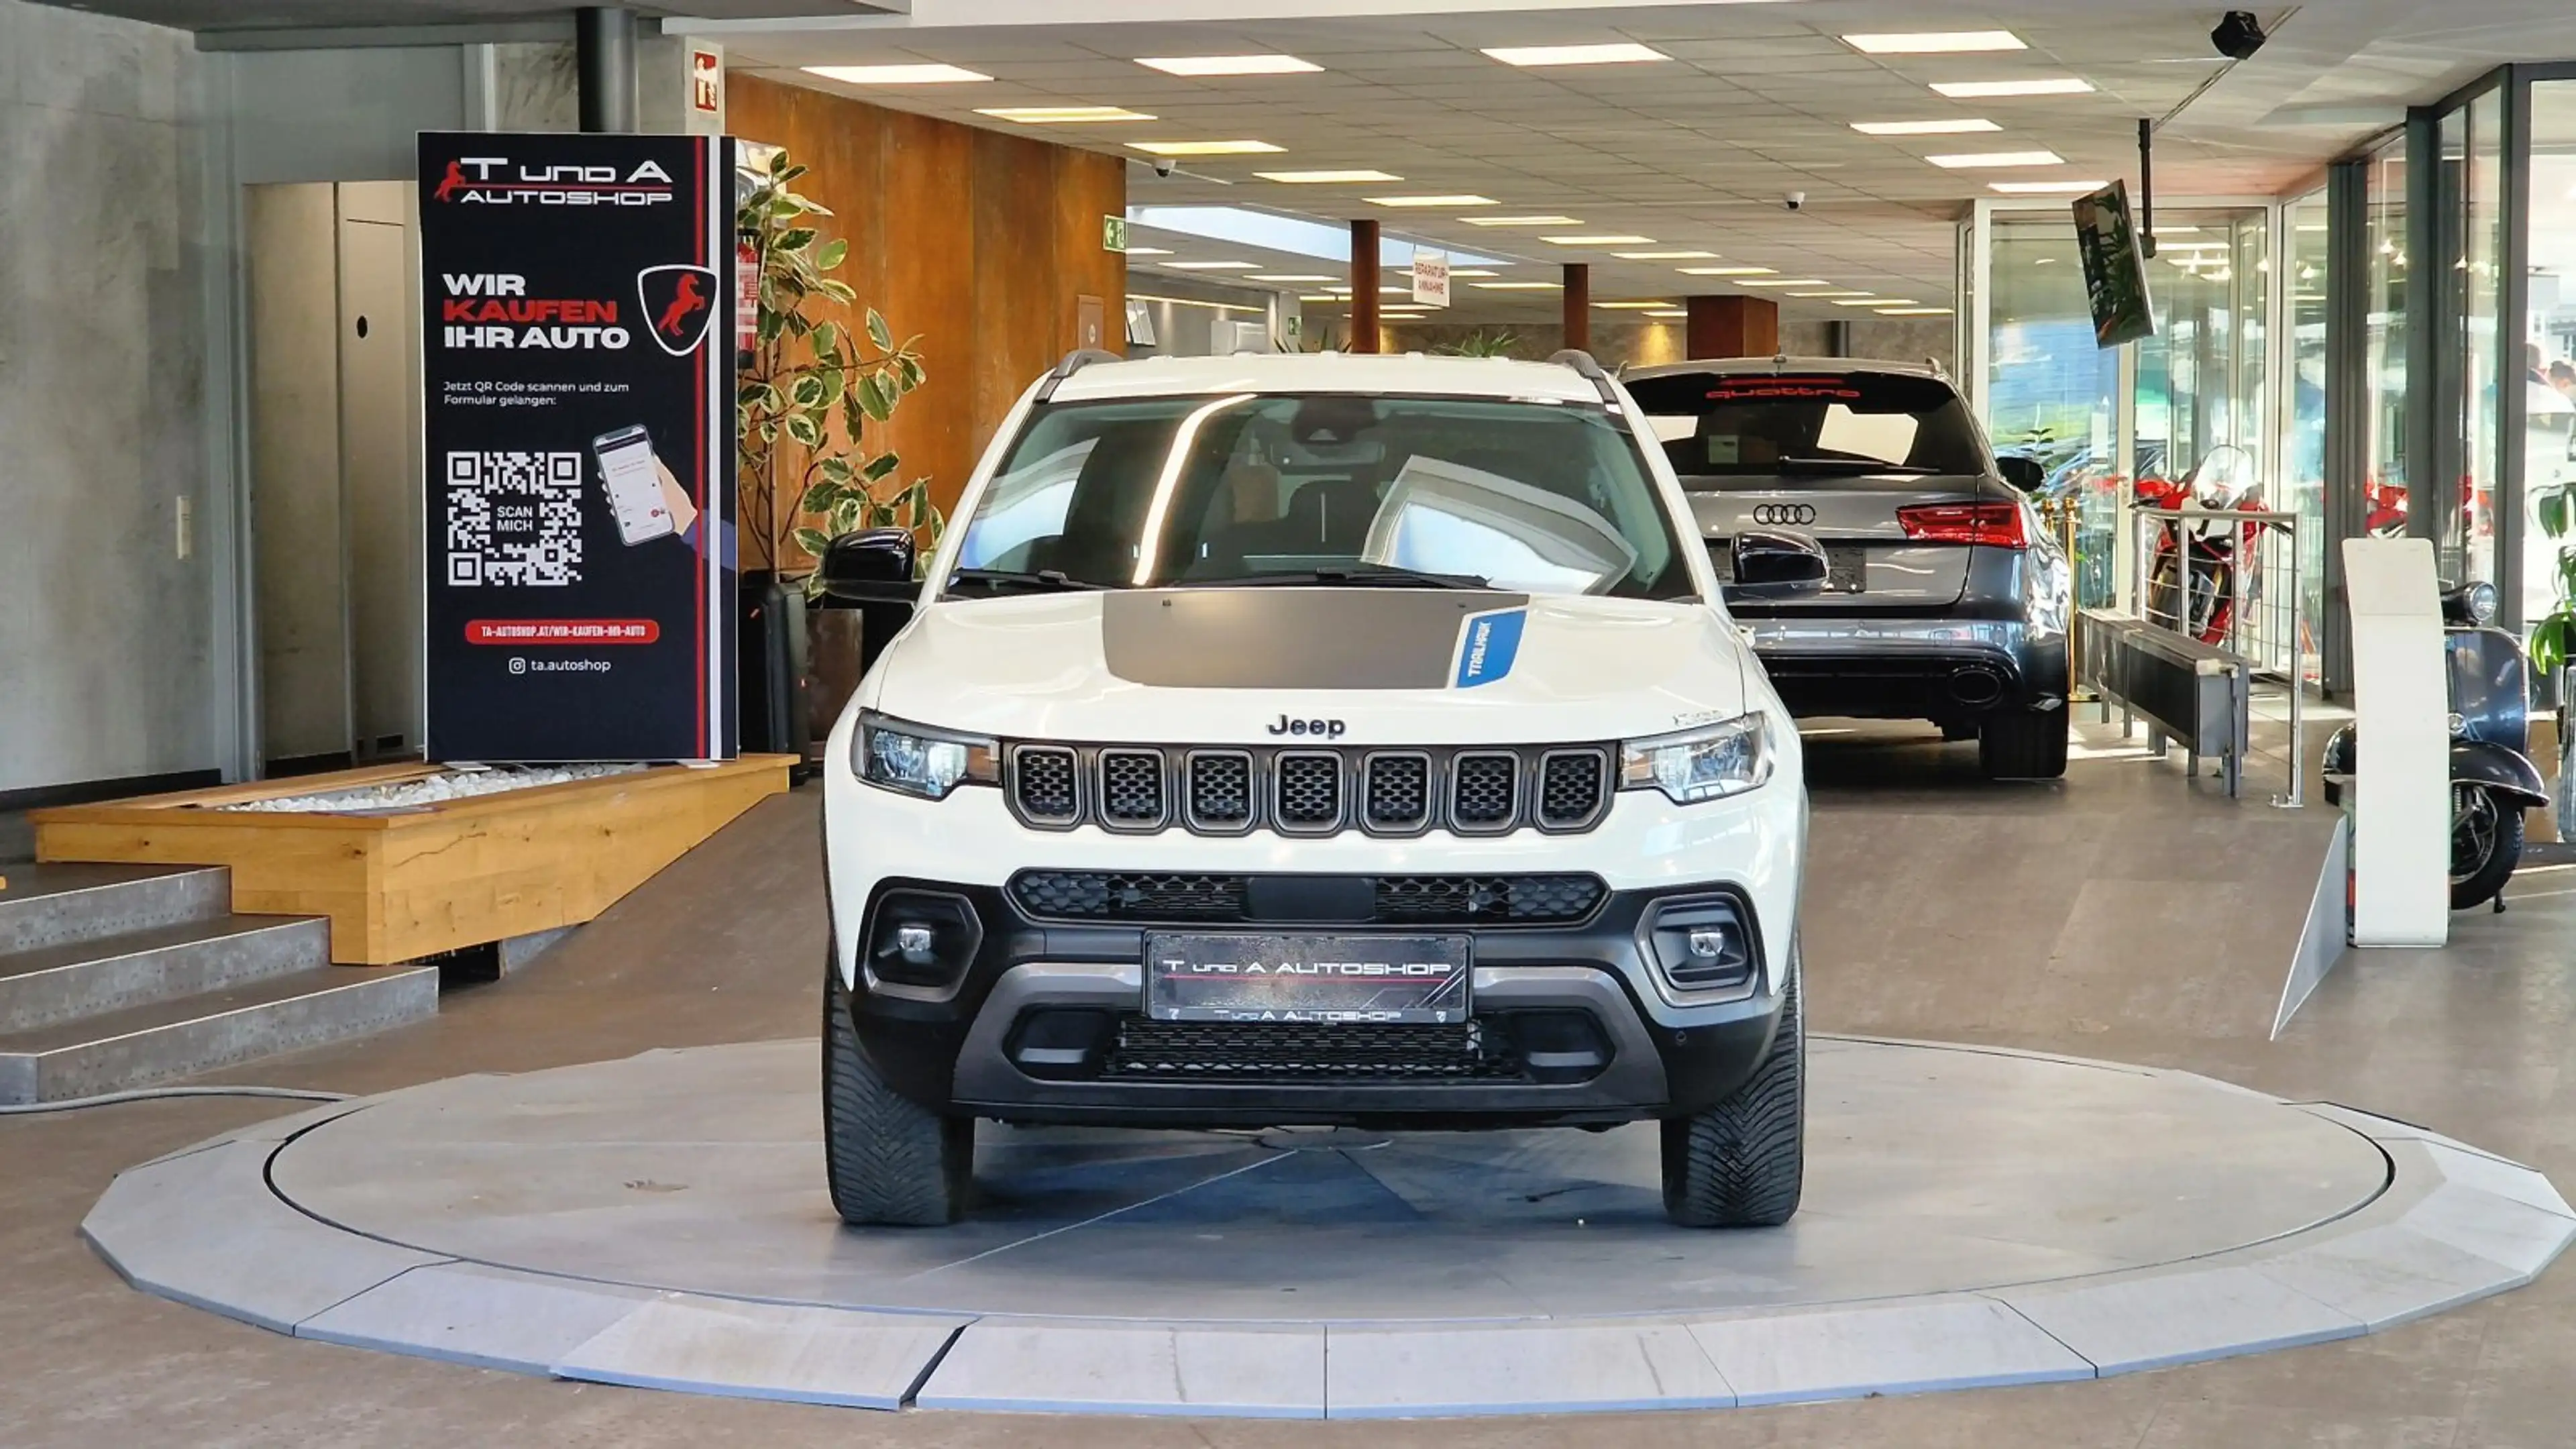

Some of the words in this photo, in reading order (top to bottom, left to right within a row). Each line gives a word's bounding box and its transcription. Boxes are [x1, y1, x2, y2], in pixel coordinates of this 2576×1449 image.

[460, 158, 508, 181] T
[626, 160, 673, 183] A
[460, 190, 673, 206] AUTOSHOP
[443, 274, 526, 296] WIR
[443, 299, 618, 323] KAUFEN
[444, 326, 515, 348] IHR
[519, 327, 631, 349] AUTO
[443, 381, 472, 392] Jetzt
[474, 382, 492, 393] QR
[494, 382, 525, 392] Code
[527, 384, 576, 392] scannen
[579, 382, 602, 392] und
[603, 384, 629, 392] zum
[1705, 388, 1860, 398] quattro
[444, 394, 497, 405] Formular
[498, 394, 557, 407] gelangen:
[496, 506, 533, 518] SCAN
[496, 520, 533, 532] MICH
[531, 658, 611, 672] ta.autoshop
[1267, 714, 1346, 739] Jeep
[1163, 960, 1185, 972] T
[1245, 961, 1267, 973] A
[1275, 962, 1452, 975] AUTOSHOP
[1214, 1010, 1230, 1020] T
[1260, 1010, 1276, 1021] A
[1283, 1010, 1402, 1022] AUTOSHOP
